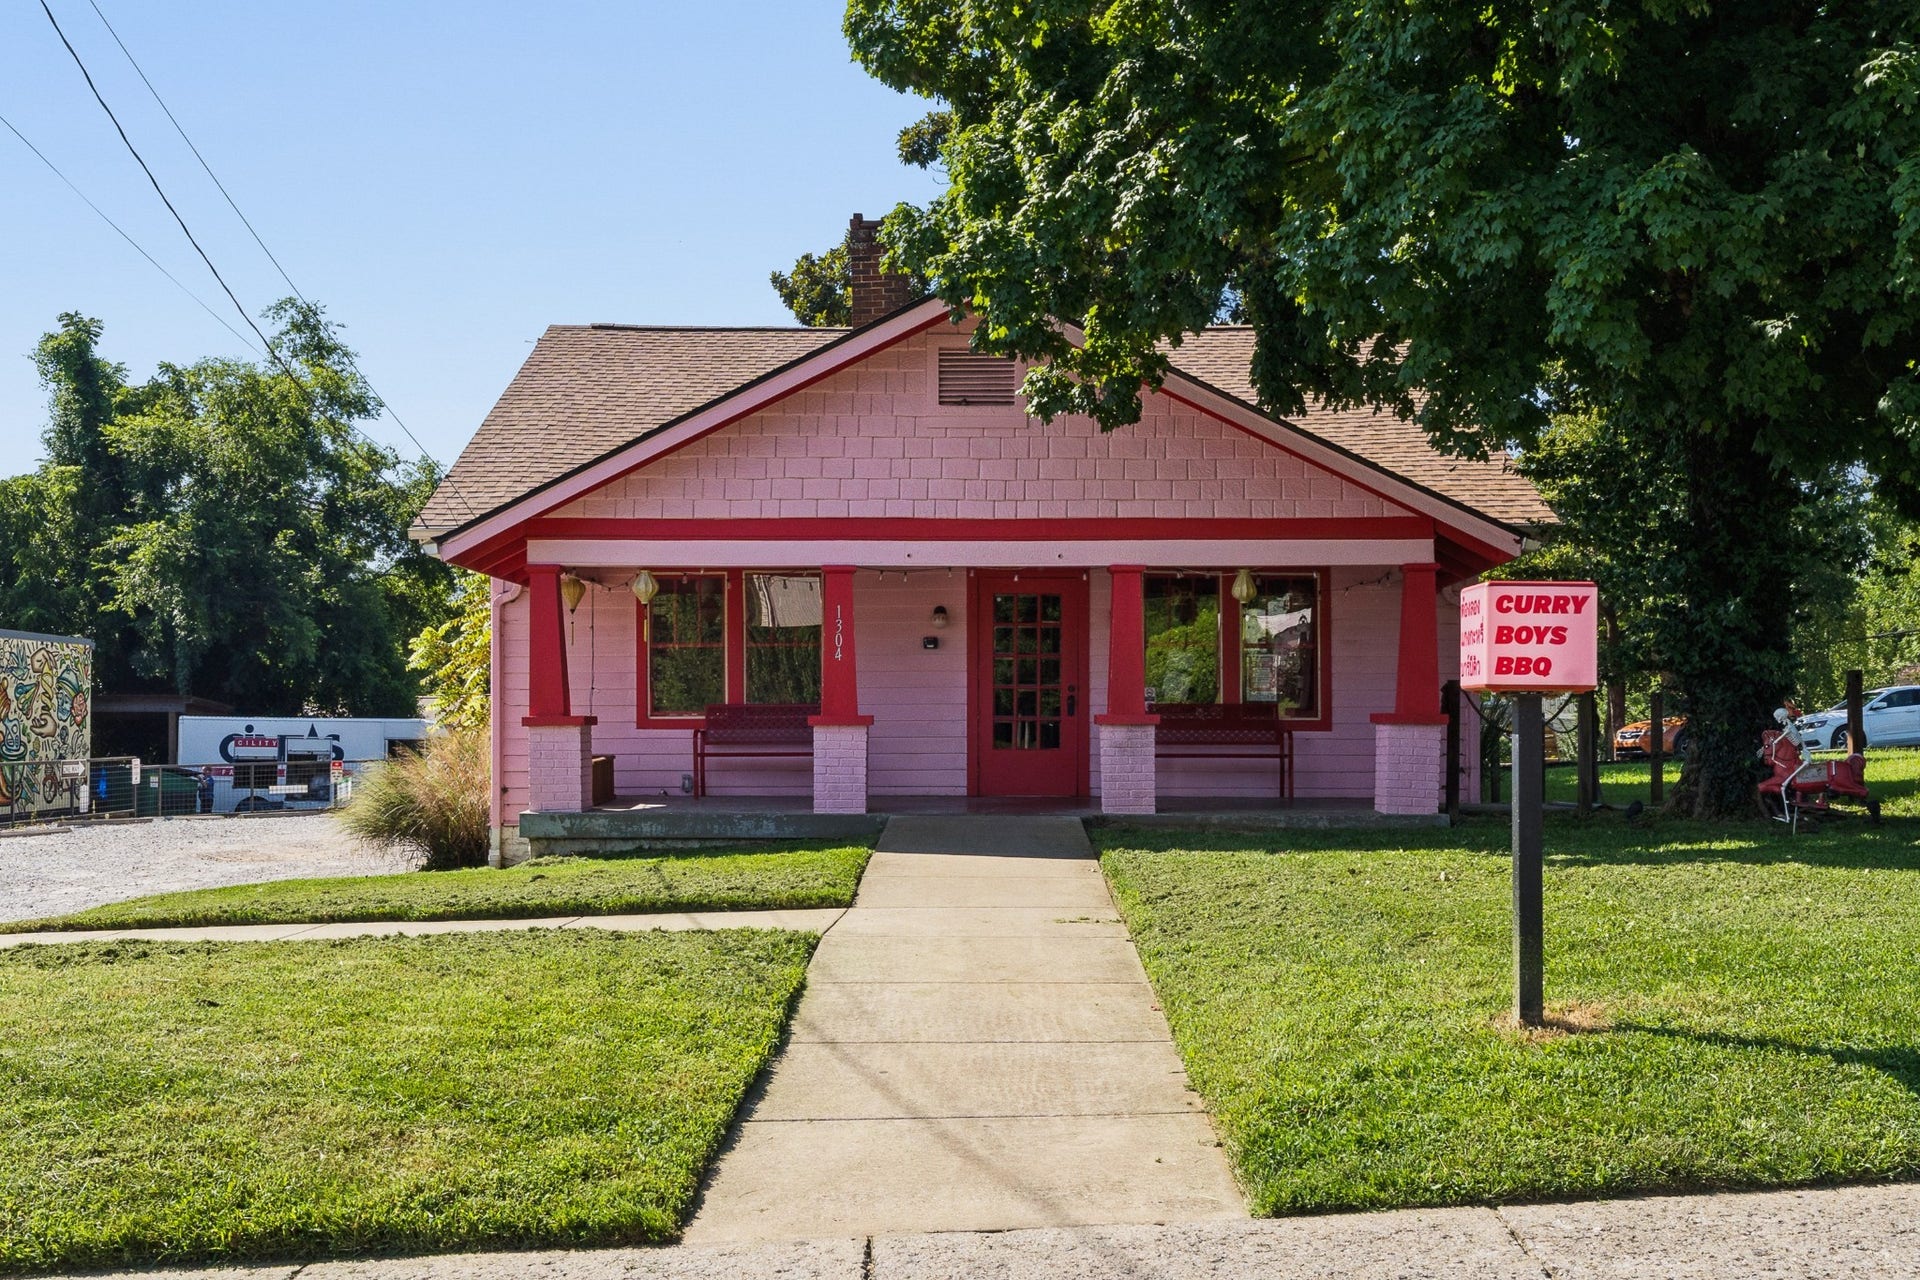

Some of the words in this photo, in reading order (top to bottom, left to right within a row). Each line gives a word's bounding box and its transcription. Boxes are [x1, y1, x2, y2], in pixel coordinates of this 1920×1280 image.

[1495, 595, 1590, 614] CURRY
[835, 605, 843, 661] 1304
[1495, 626, 1568, 645] BOYS
[1495, 657, 1552, 677] BBQ
